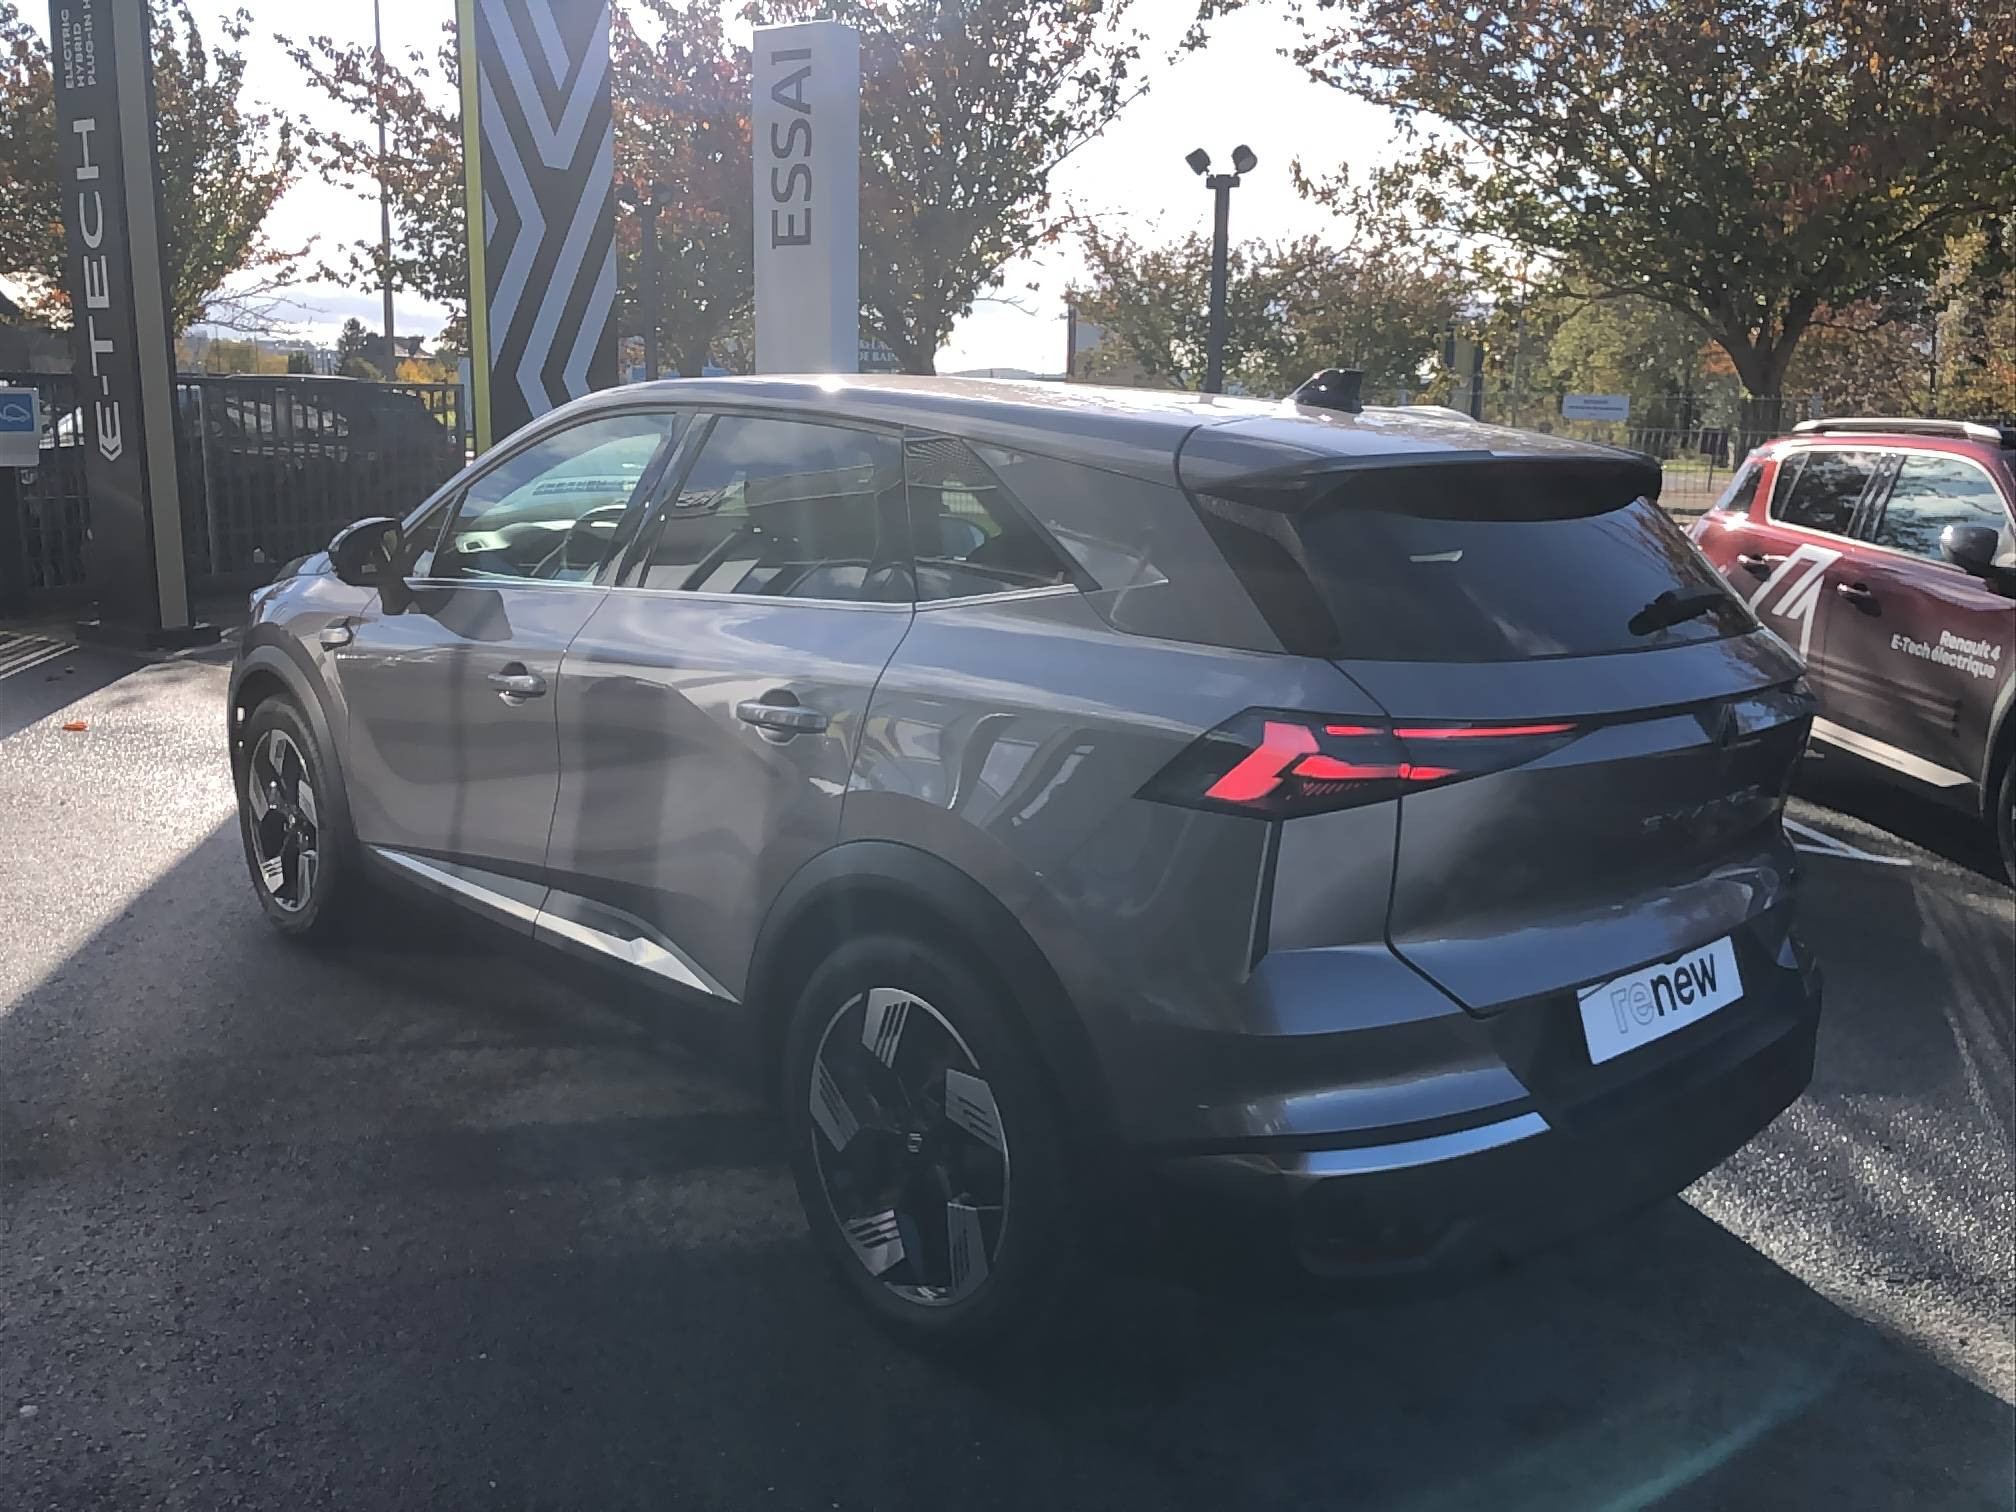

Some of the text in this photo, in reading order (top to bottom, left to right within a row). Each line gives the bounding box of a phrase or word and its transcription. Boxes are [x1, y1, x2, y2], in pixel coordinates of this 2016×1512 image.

[61, 9, 74, 88] ELECTRIC
[73, 23, 85, 87] HYBRID
[83, 14, 96, 86] PLUG-IN
[771, 48, 812, 249] ESSAI
[73, 118, 122, 461] E-TECH
[1891, 633, 1996, 679] E-Tech électrique
[1940, 630, 2001, 661] Renault 4
[1610, 953, 1717, 1034] renew
